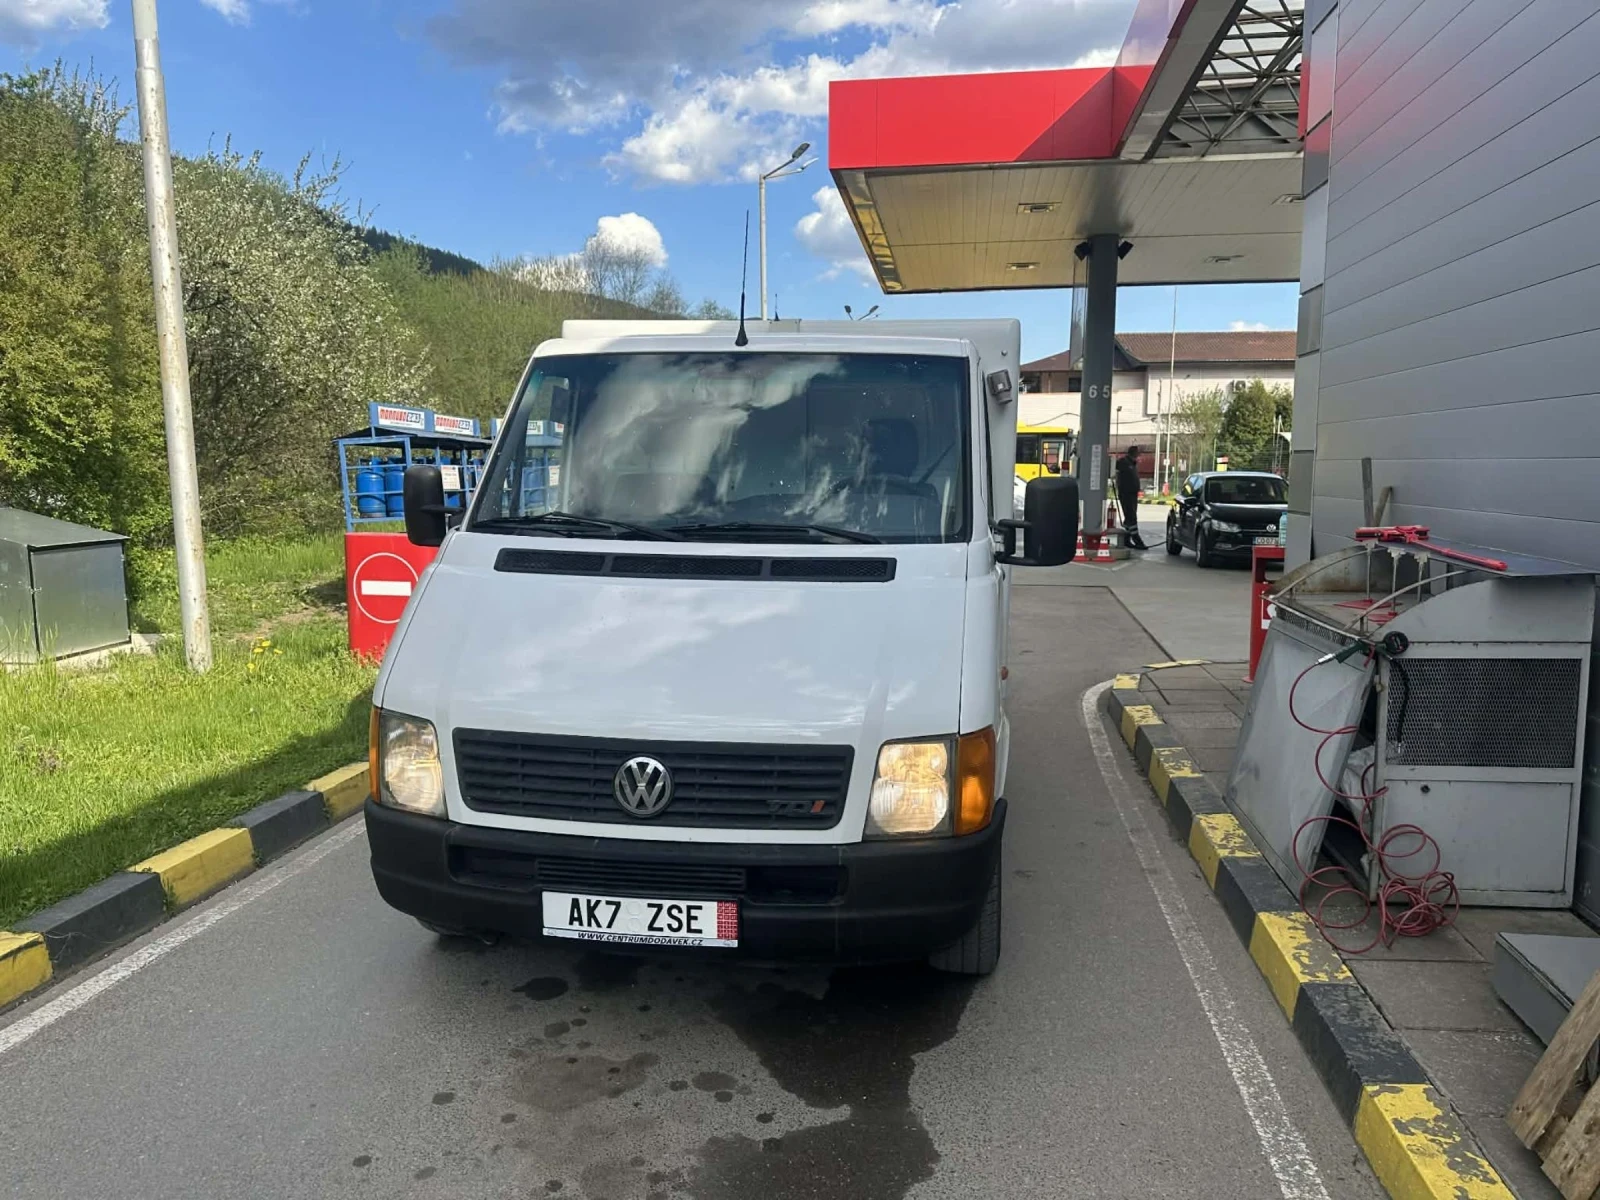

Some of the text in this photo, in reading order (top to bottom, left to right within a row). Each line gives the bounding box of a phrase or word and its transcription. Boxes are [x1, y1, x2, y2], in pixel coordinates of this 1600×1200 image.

[1089, 384, 1111, 399] 6 5
[614, 756, 674, 816] VW
[569, 897, 621, 929] AK7
[647, 903, 703, 934] ZSE
[577, 932, 704, 946] WWW.CENTRUMDODAVEK.CZ
